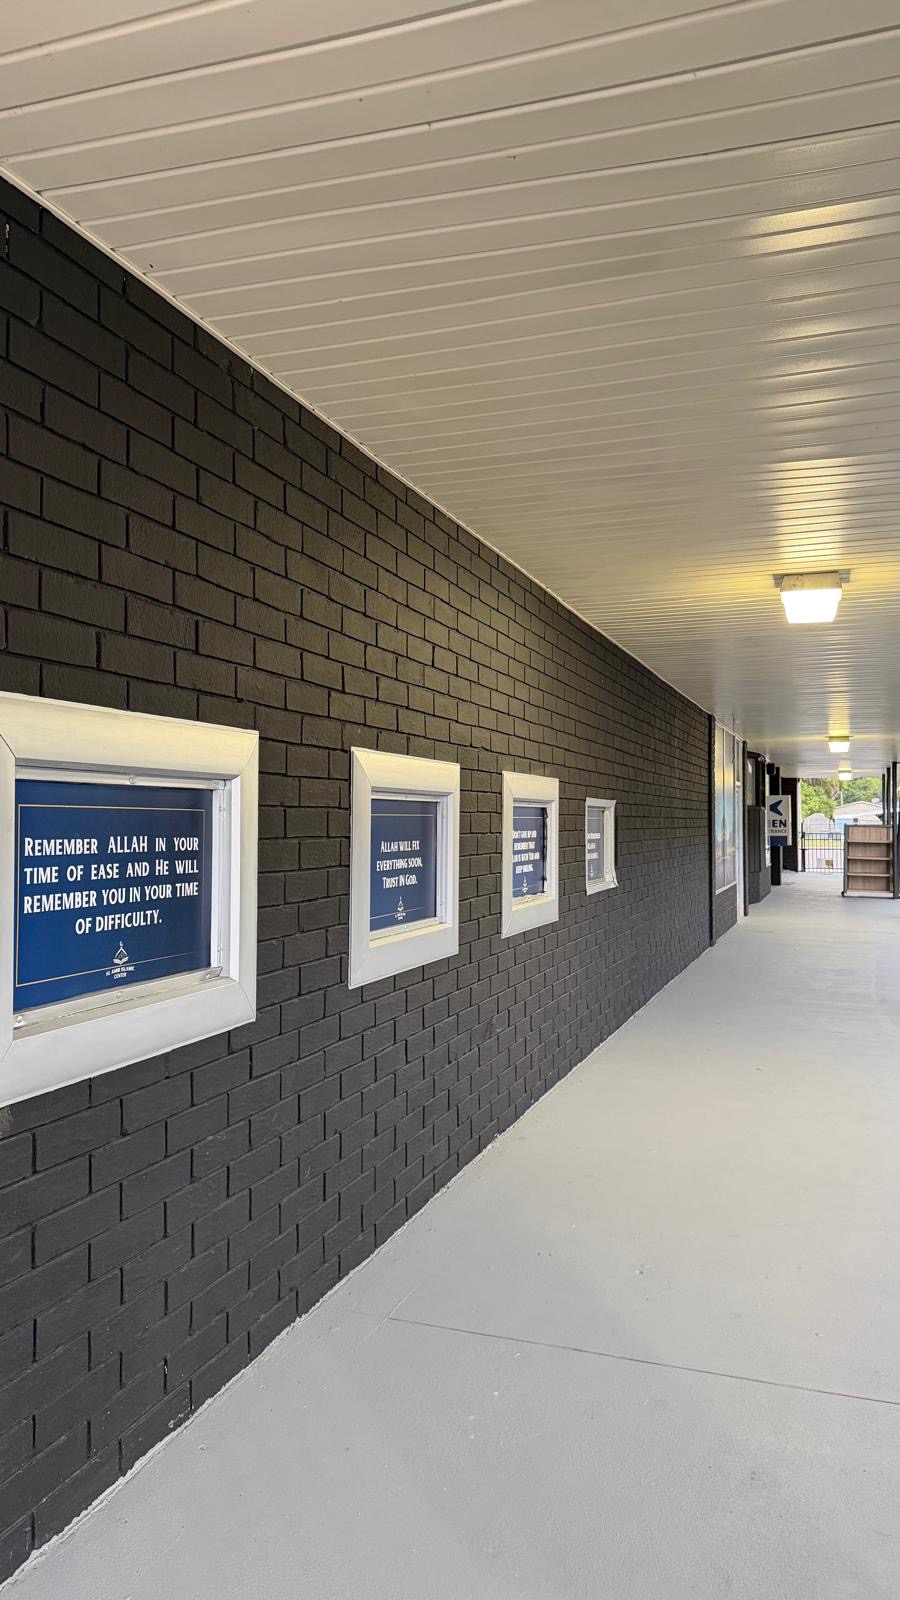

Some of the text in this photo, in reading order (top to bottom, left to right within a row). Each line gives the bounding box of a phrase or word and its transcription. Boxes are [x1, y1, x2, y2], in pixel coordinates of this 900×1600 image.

[768, 820, 786, 828] EN
[24, 836, 199, 857] REMEMBER ALLAH IN YOUR
[380, 840, 420, 853] ALLAH WILL FIX
[24, 859, 199, 884] TIME OF EASE AND HE WILL
[376, 858, 408, 872] EVERYTHING
[382, 876, 398, 889] TRUST
[399, 874, 405, 887] IN
[24, 882, 199, 914] REMEMBER YOU IN YOUR TIME
[75, 910, 162, 935] OF DIFFICULTY.
